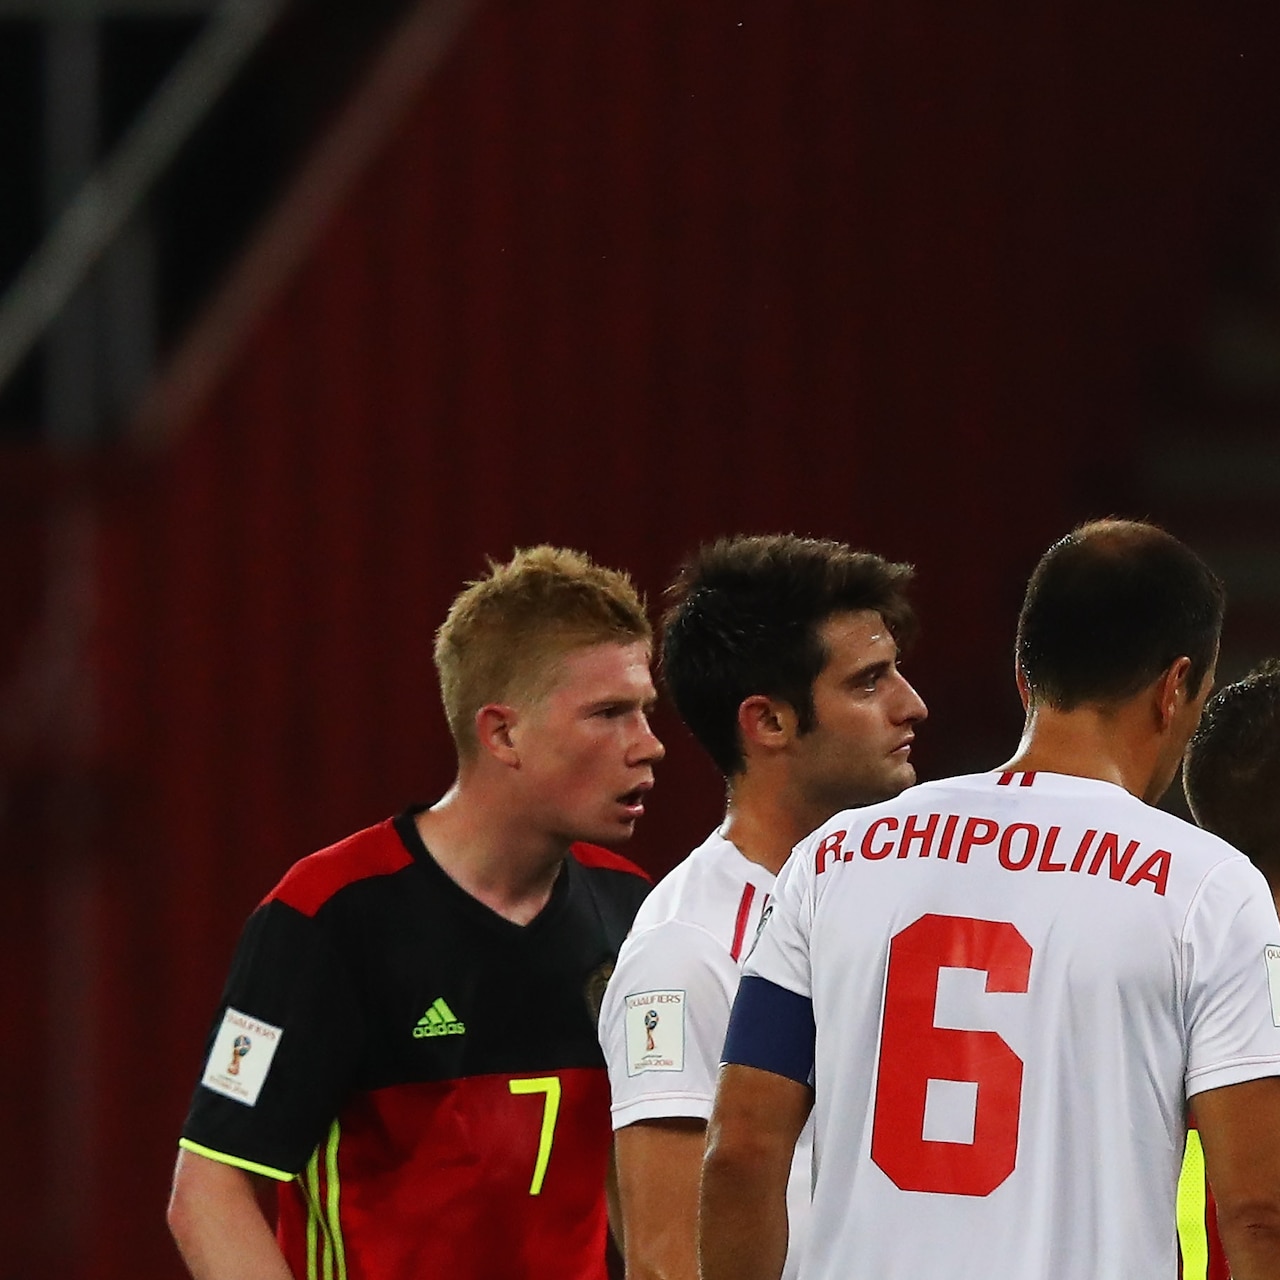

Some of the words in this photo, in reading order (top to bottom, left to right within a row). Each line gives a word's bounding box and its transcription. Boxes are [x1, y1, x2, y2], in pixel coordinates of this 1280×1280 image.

[814, 813, 1173, 897] R.CHIPOLINA
[412, 1022, 466, 1039] adidas
[870, 913, 1034, 1197] 6
[508, 1076, 562, 1196] 7
